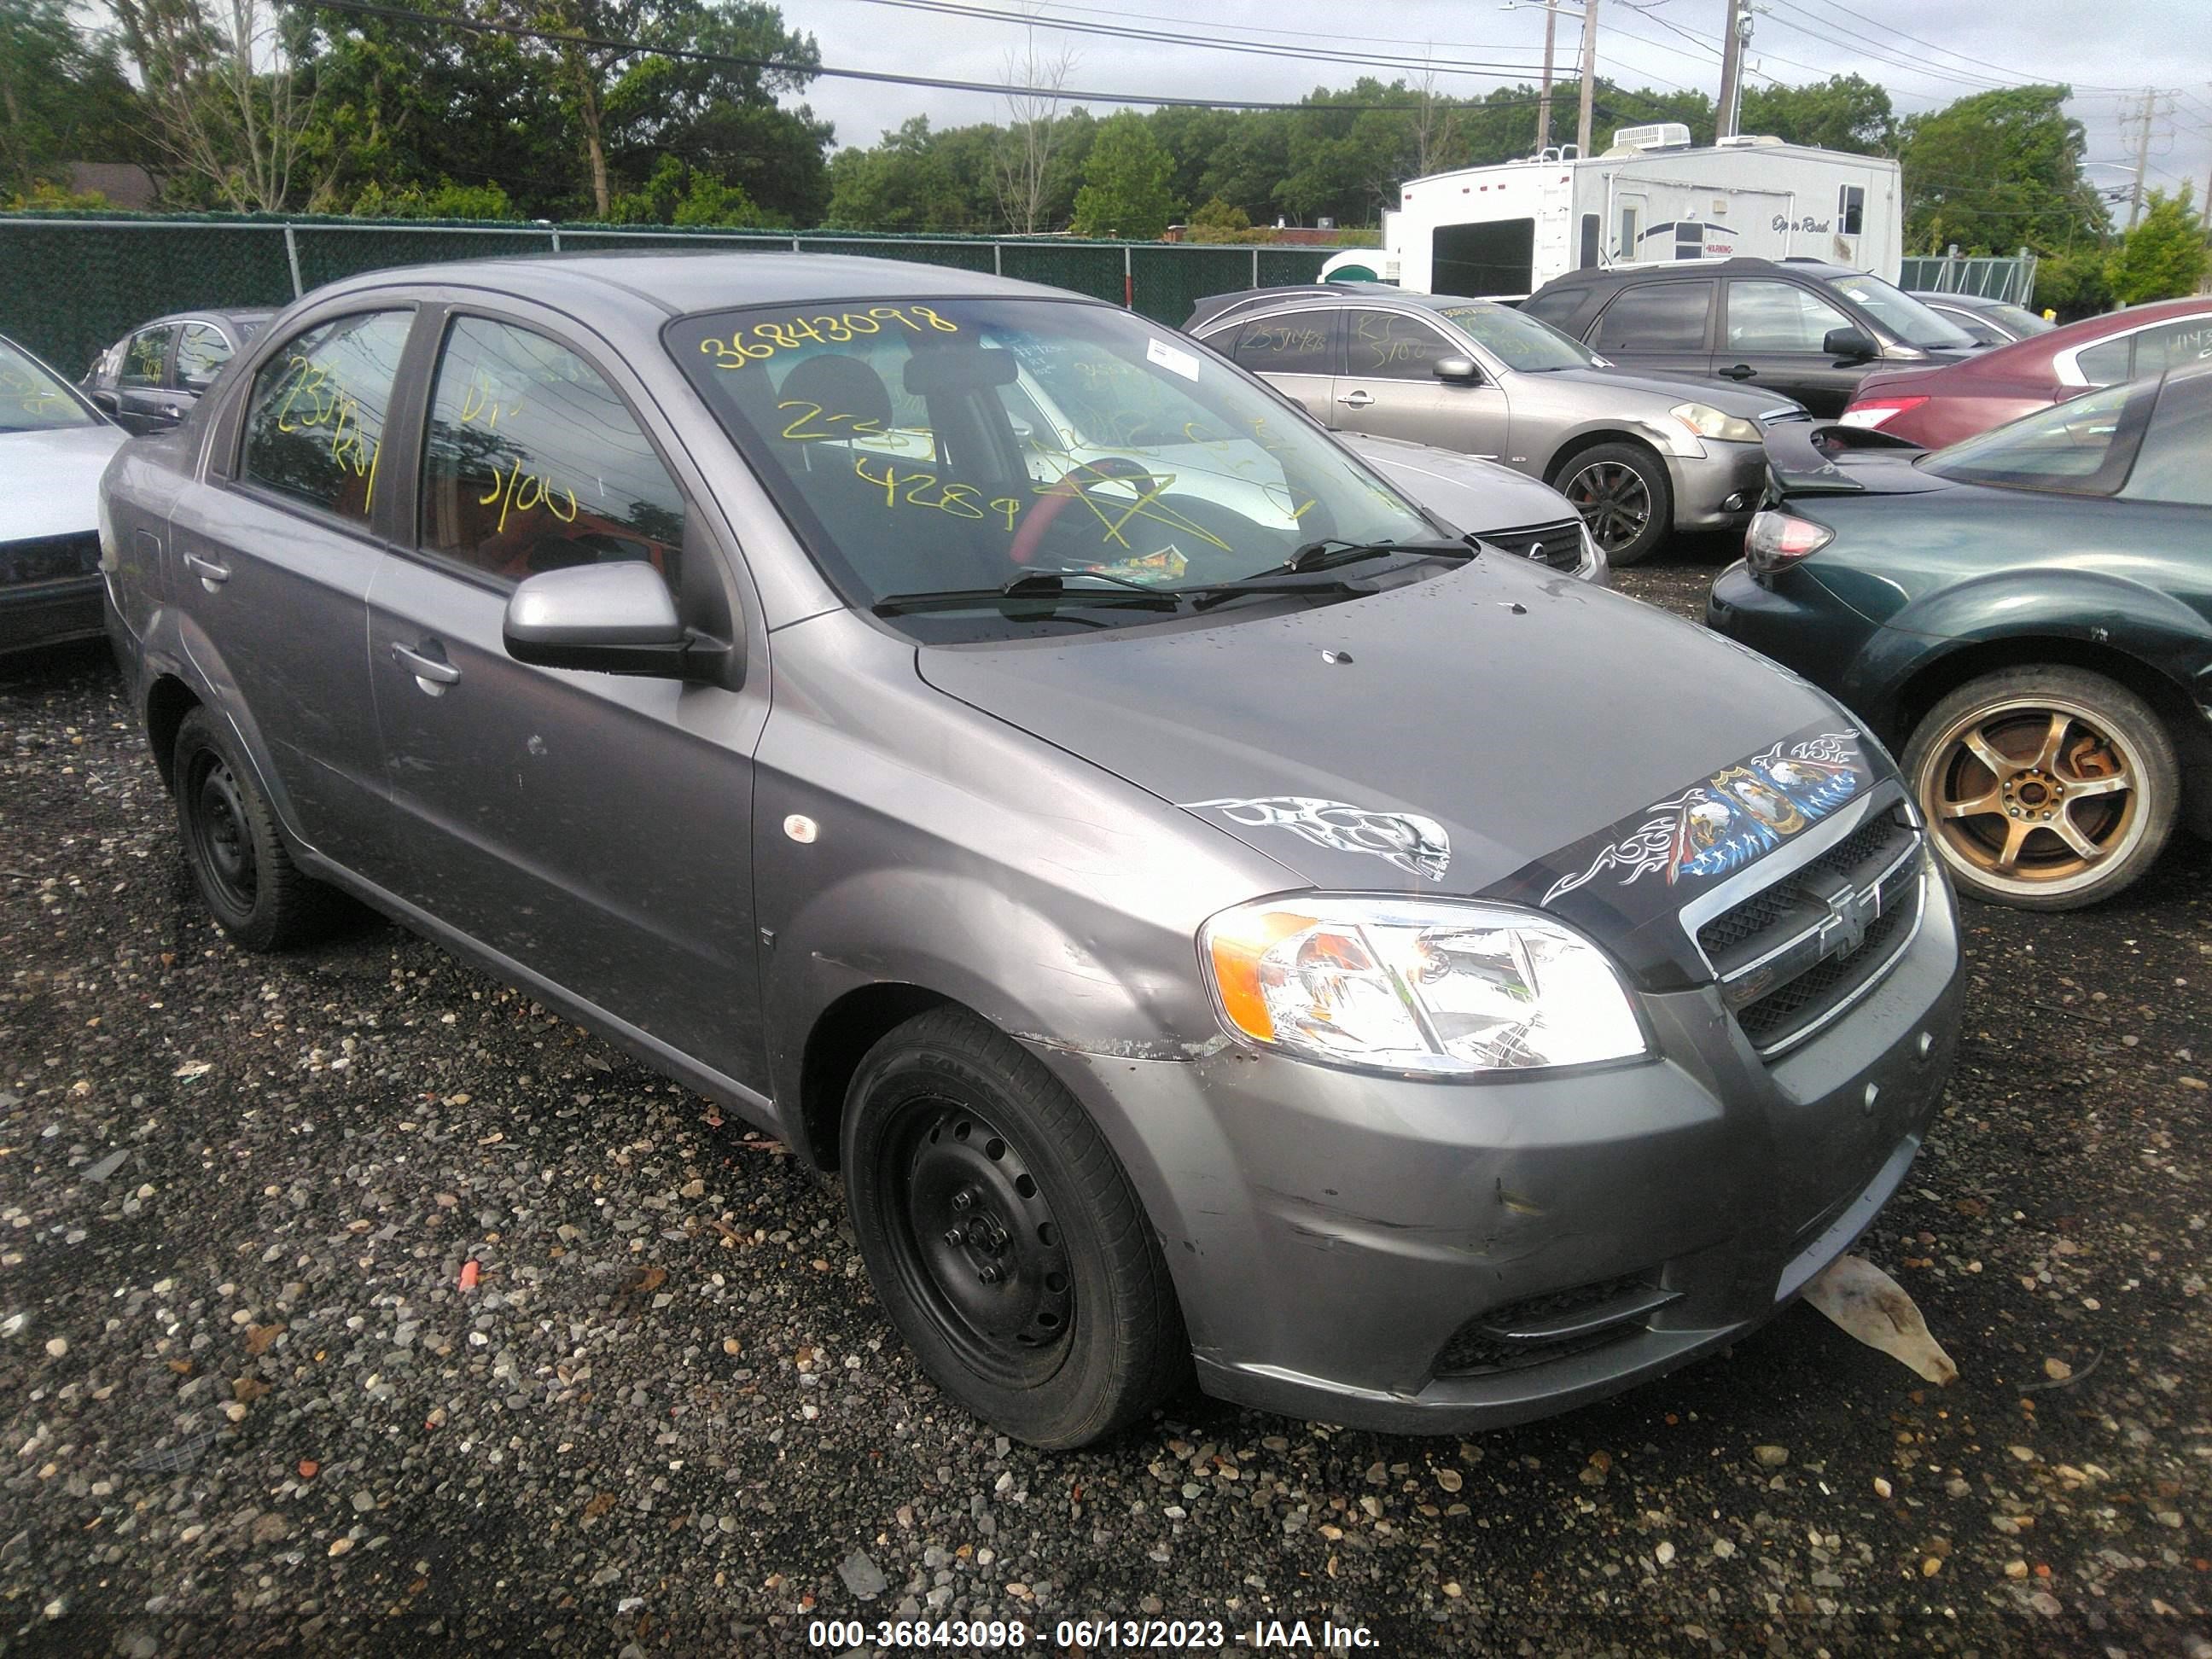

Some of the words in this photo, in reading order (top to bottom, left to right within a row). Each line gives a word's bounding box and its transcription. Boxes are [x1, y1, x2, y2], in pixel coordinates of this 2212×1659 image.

[1772, 214, 1800, 234] Opn
[1708, 244, 1732, 254] WARNING
[700, 306, 958, 369] 36843098
